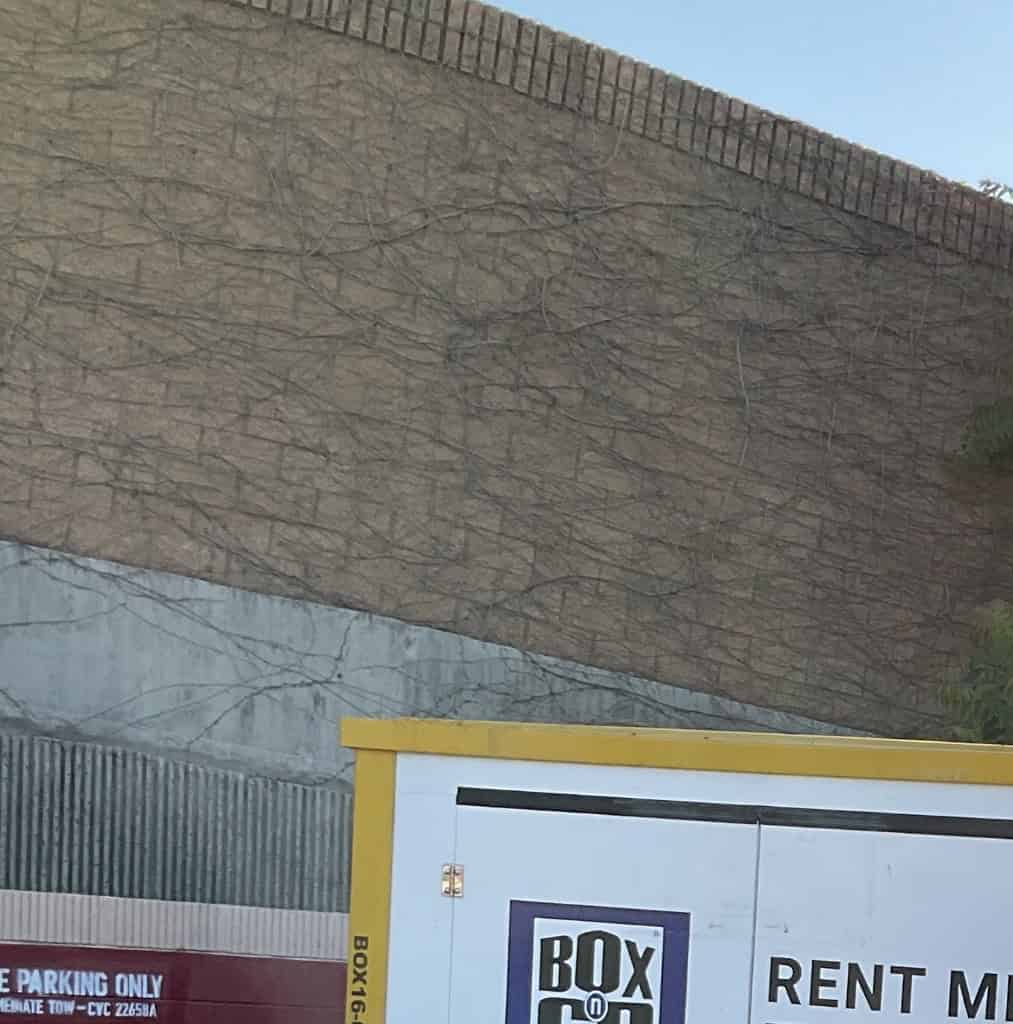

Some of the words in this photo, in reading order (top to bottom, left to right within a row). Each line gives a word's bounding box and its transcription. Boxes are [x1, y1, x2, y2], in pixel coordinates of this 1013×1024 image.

[16, 968, 109, 997] PARKING
[115, 973, 164, 999] ONLY
[538, 930, 656, 1000] BOX
[767, 956, 927, 1016] RENT
